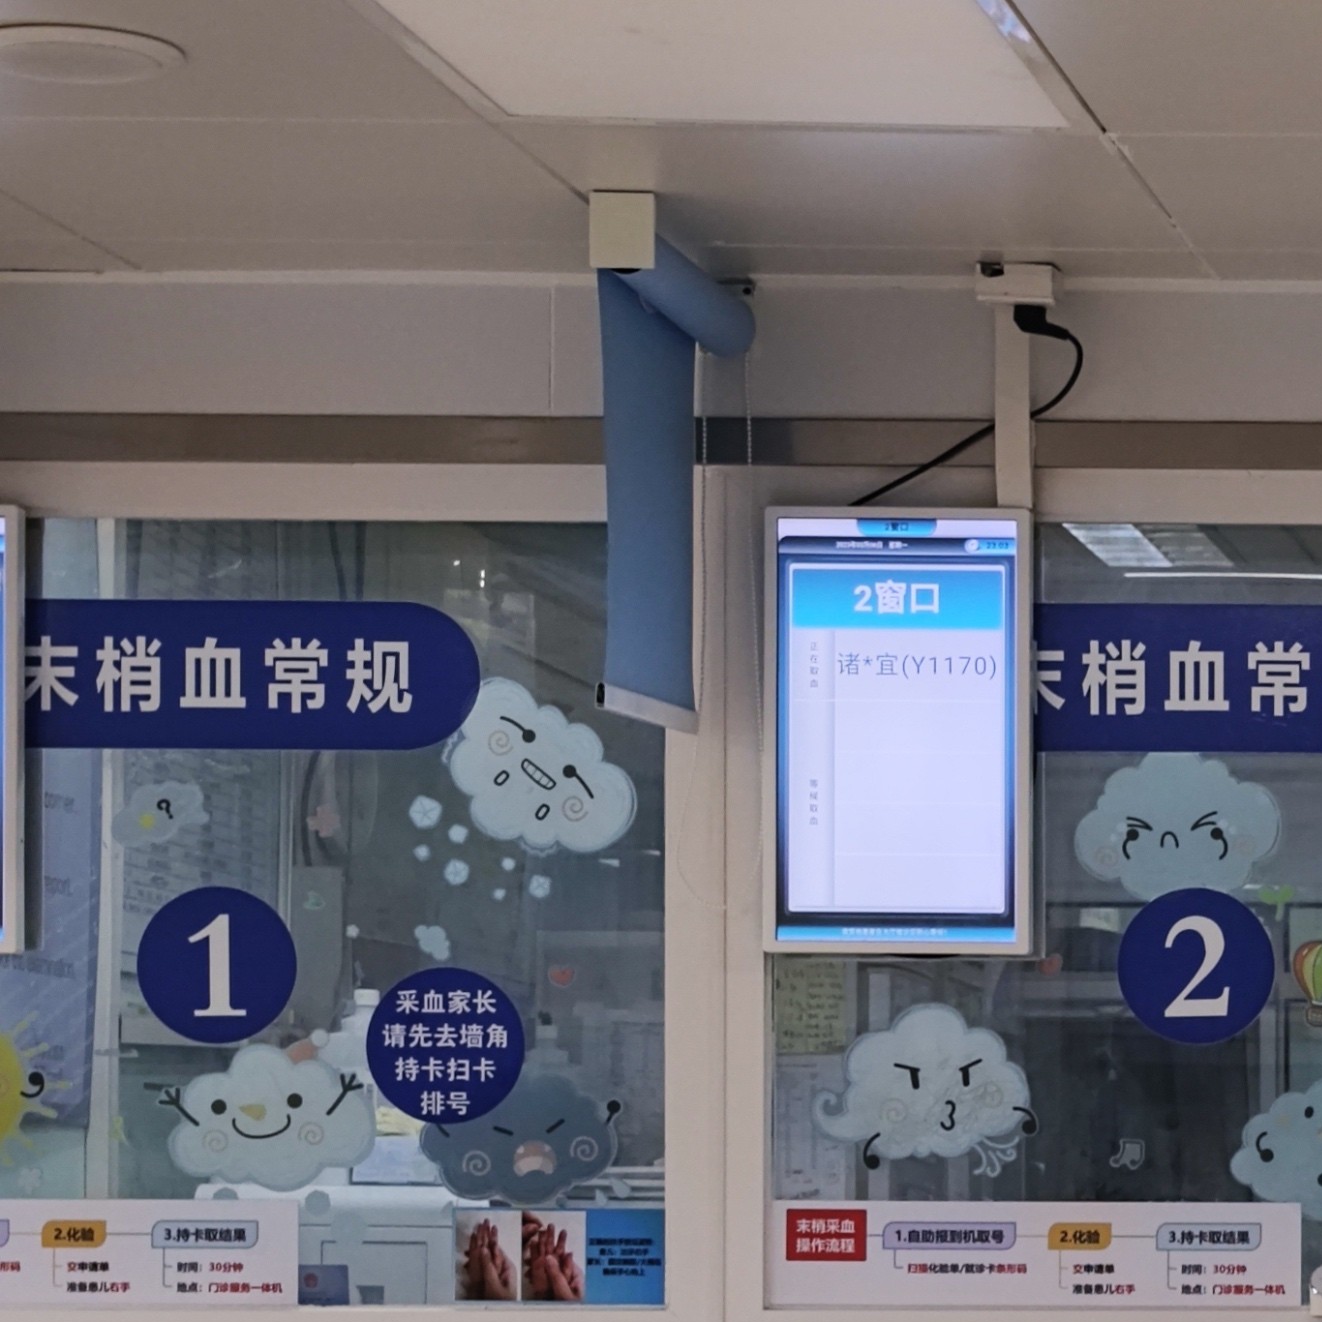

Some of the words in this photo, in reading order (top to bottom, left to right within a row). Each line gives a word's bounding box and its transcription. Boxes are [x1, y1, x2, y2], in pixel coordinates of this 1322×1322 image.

[853, 579, 941, 615] 2窗口
[25, 635, 413, 714] 末梢血常规
[187, 913, 247, 1018] 1
[1163, 914, 1230, 1018] 2
[395, 989, 498, 1015] 采血家长
[382, 1023, 509, 1050] 请先去墙角
[394, 1056, 497, 1083] 持卡扫卡
[420, 1090, 471, 1116] 排号
[53, 1228, 96, 1243] 2.化验
[163, 1227, 247, 1243] 3.持卡取结果
[796, 1219, 856, 1235] 末梢采血
[895, 1229, 1005, 1245] 1.自助报到机取号
[1059, 1230, 1101, 1245] 2.化验
[1168, 1230, 1250, 1245] 3.持卡取结果
[796, 1238, 856, 1254] 操作流程
